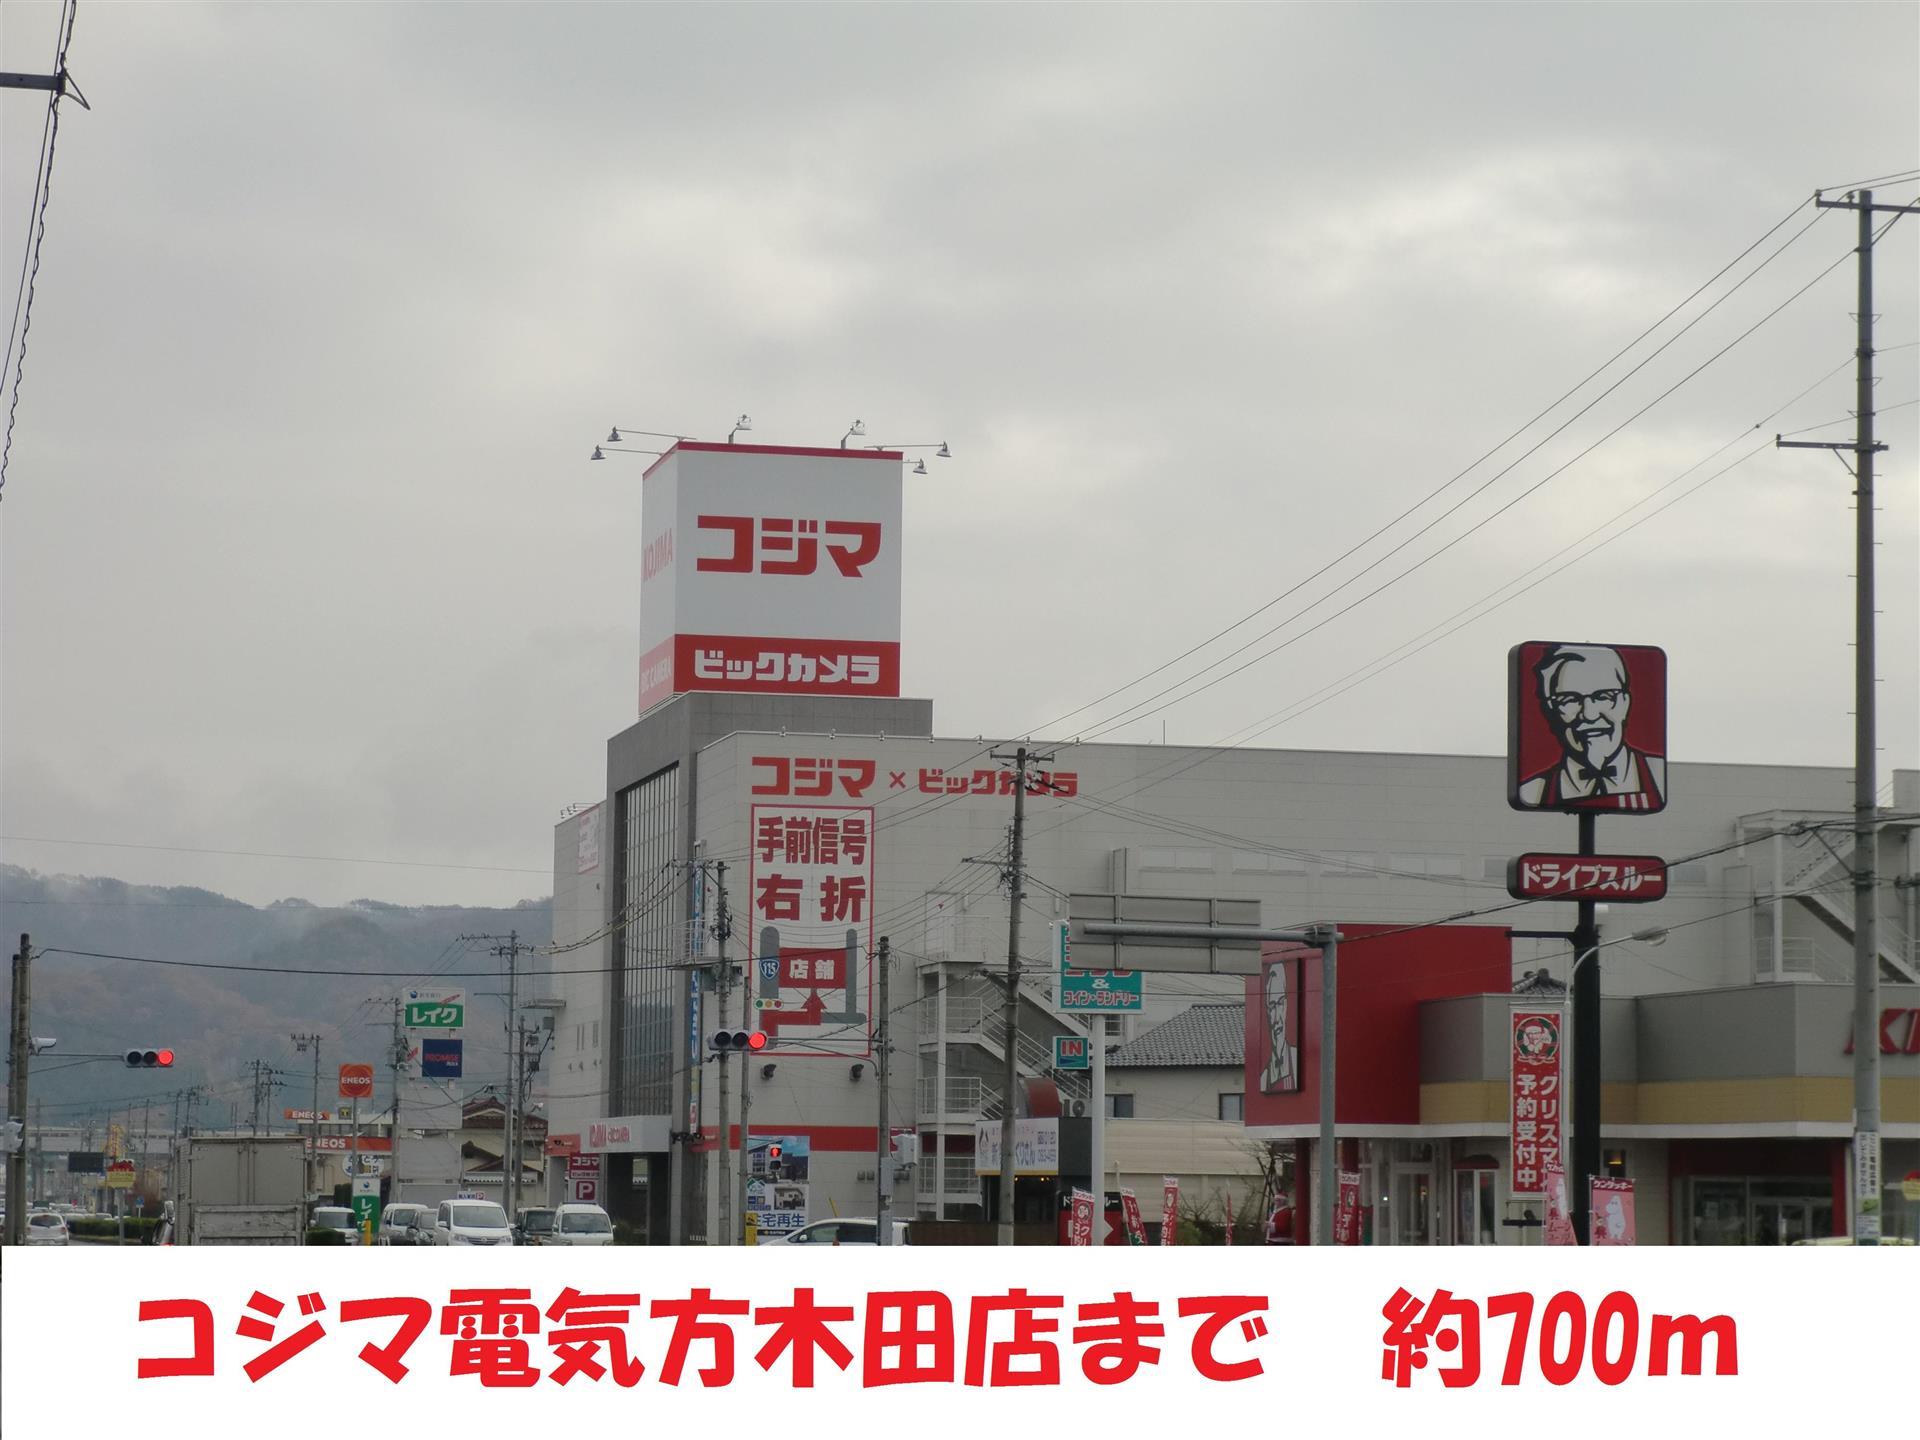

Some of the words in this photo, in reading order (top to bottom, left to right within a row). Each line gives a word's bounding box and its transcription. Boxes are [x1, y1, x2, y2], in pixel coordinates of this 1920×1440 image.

[697, 515, 881, 577] コジマ
[695, 650, 880, 685] ビックカメラ
[752, 757, 876, 798] コジマ
[757, 816, 867, 865] 手前信号
[1523, 862, 1662, 891] ドライブスルー
[757, 874, 866, 922] 右折
[763, 962, 777, 975] 115
[789, 959, 835, 980] 店舗
[412, 1007, 457, 1024] レイク
[1061, 1040, 1083, 1057] IN
[341, 1077, 371, 1085] ENEOS
[1516, 1074, 1537, 1188] 予約受付中
[572, 1157, 600, 1166] コジマ
[579, 1182, 593, 1199] P
